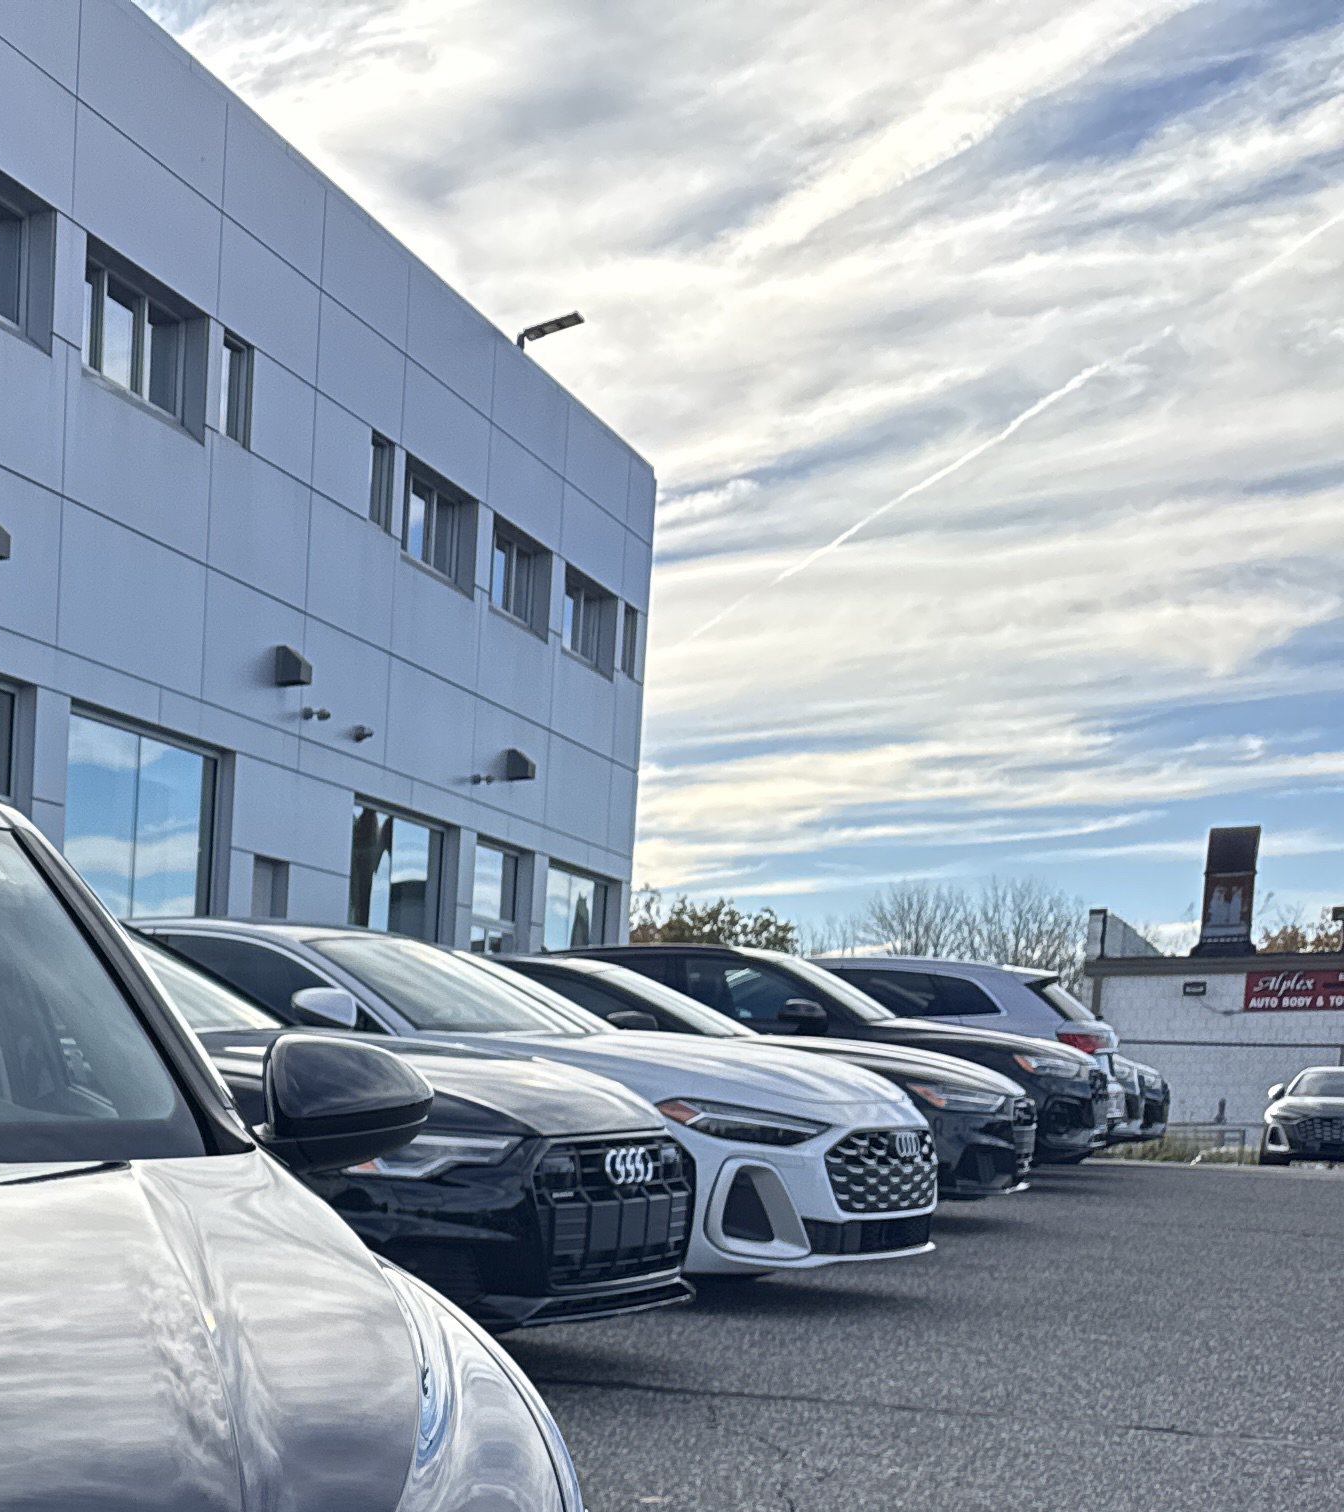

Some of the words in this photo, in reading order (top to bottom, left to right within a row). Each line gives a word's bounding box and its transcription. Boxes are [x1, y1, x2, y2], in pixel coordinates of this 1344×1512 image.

[1248, 996, 1278, 1008] AUTO
[1282, 995, 1312, 1008] BODY
[1315, 995, 1324, 1007] &
[1329, 995, 1344, 1007] TO
